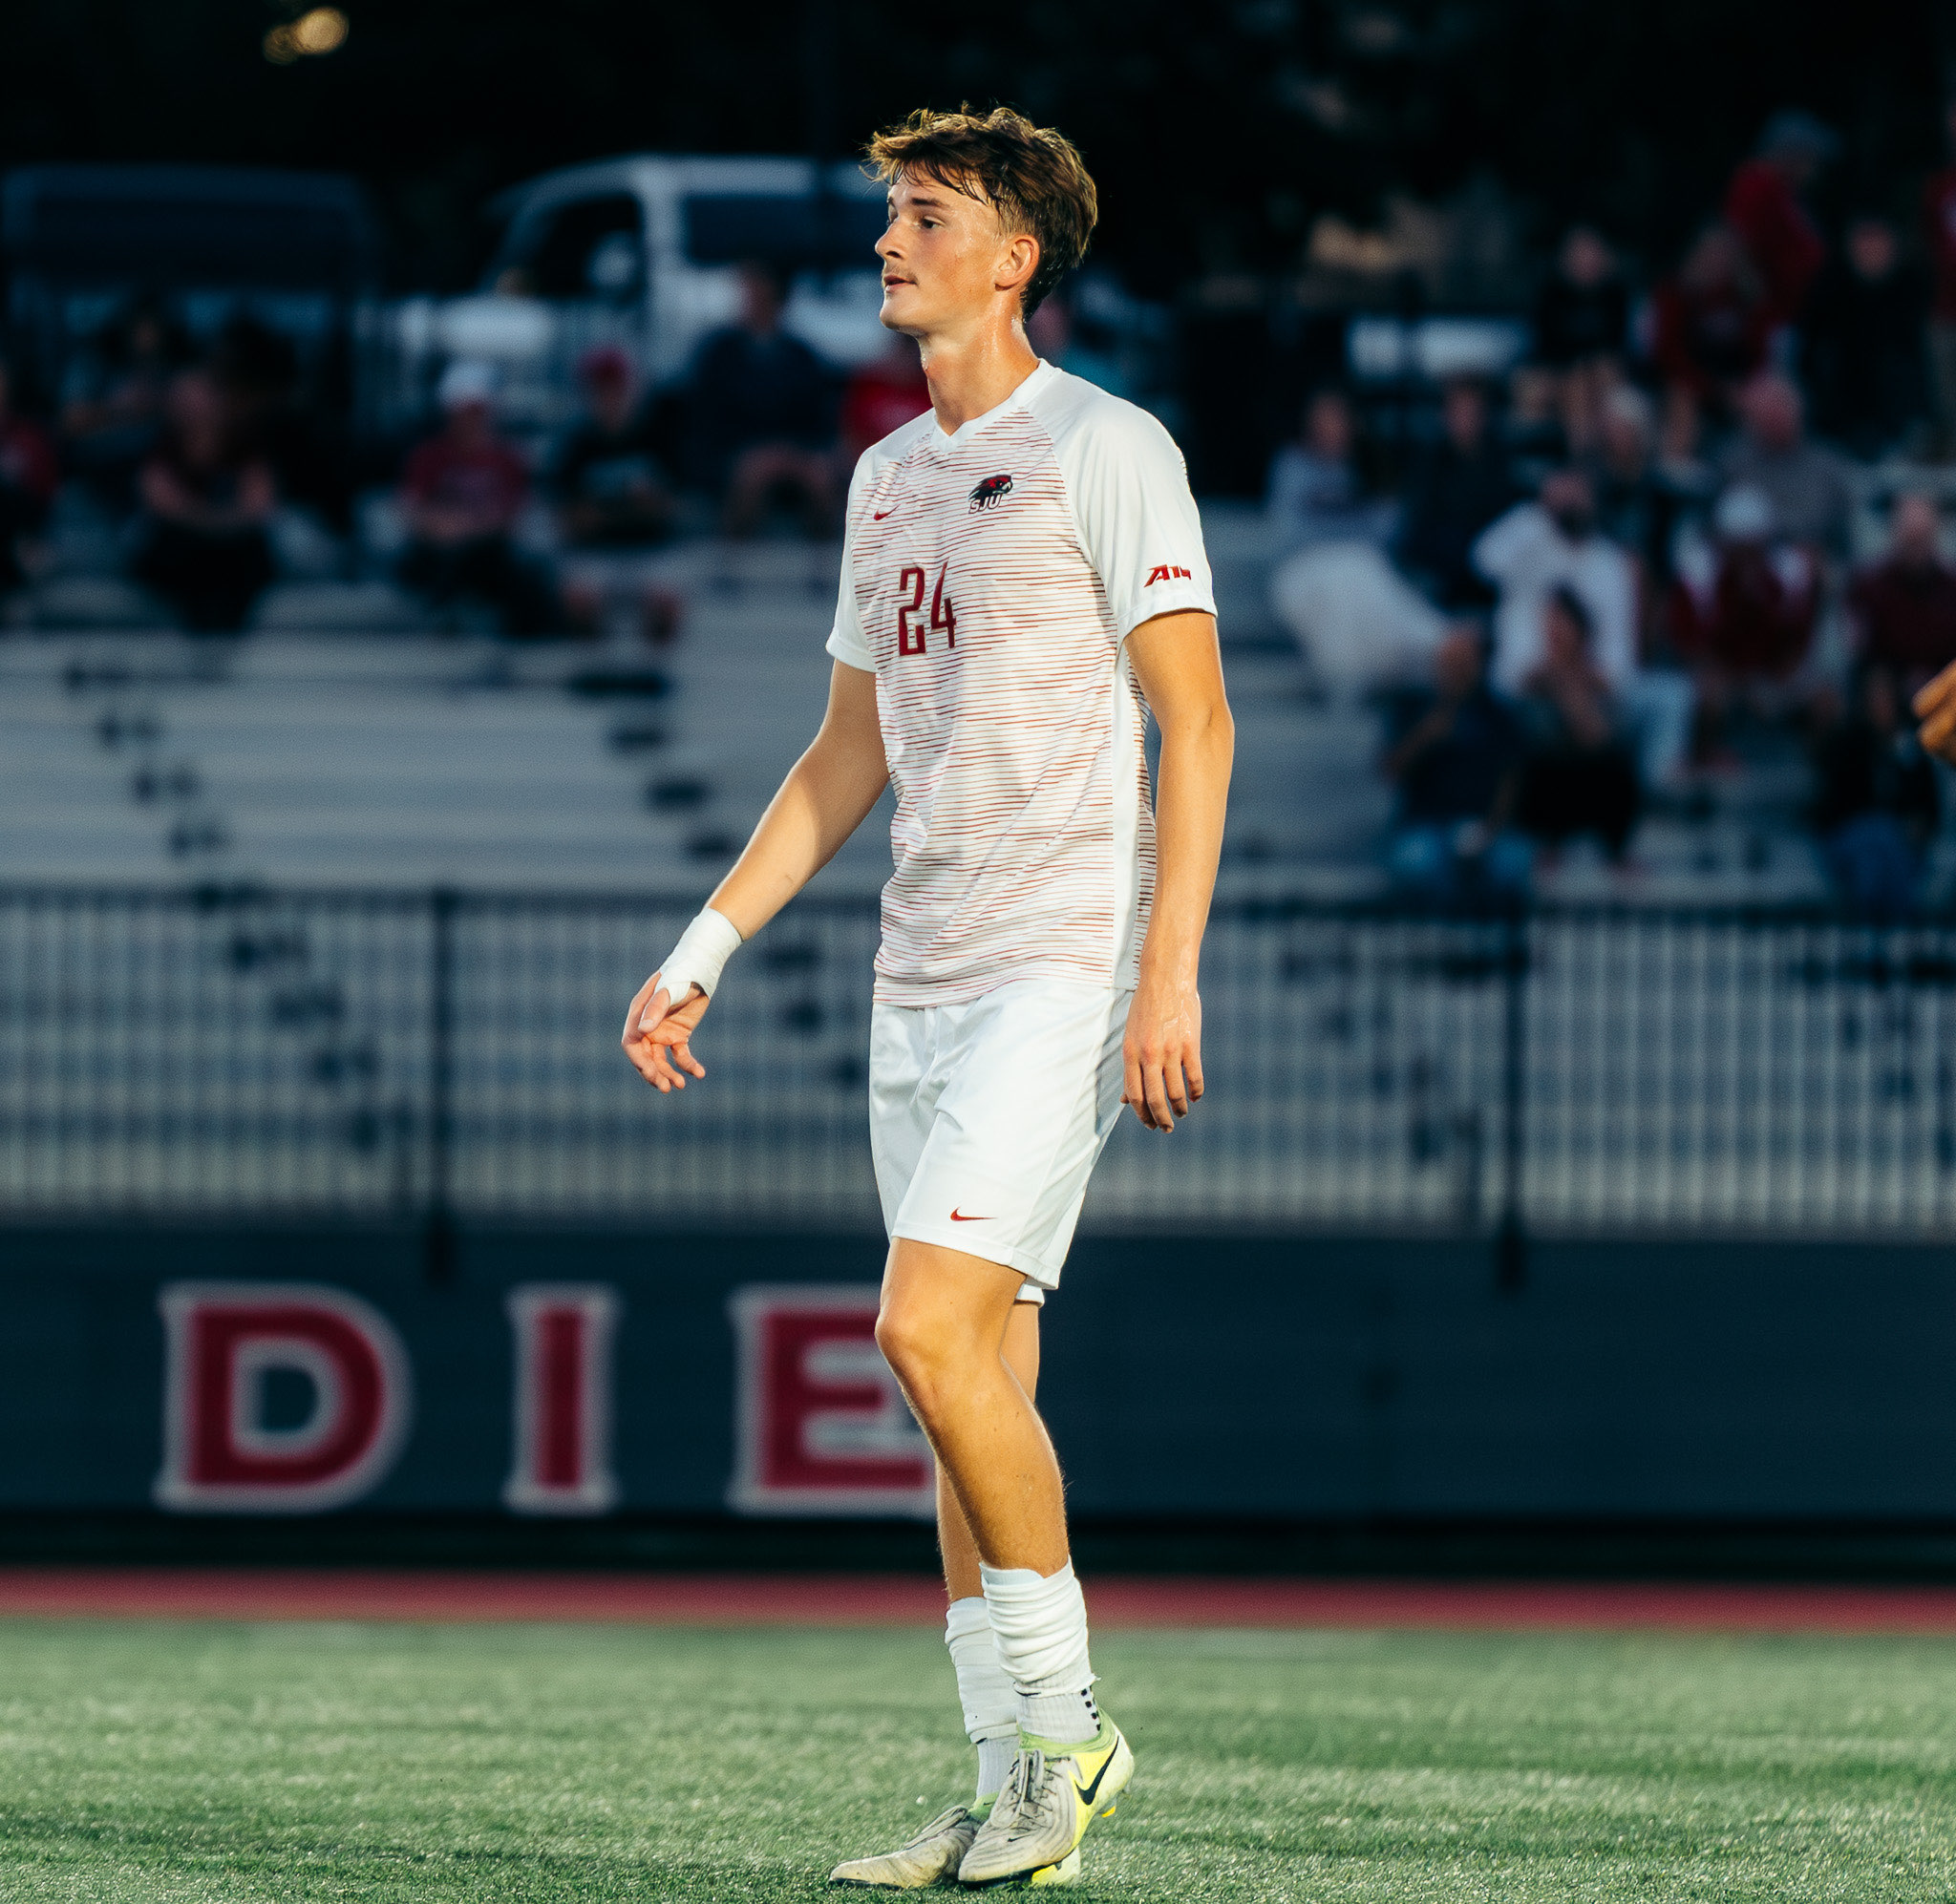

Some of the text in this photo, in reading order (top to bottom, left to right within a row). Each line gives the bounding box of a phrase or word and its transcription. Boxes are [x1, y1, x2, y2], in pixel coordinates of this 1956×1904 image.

[968, 494, 1003, 514] SJU
[898, 560, 956, 656] 24
[153, 1280, 938, 1518] DIE
